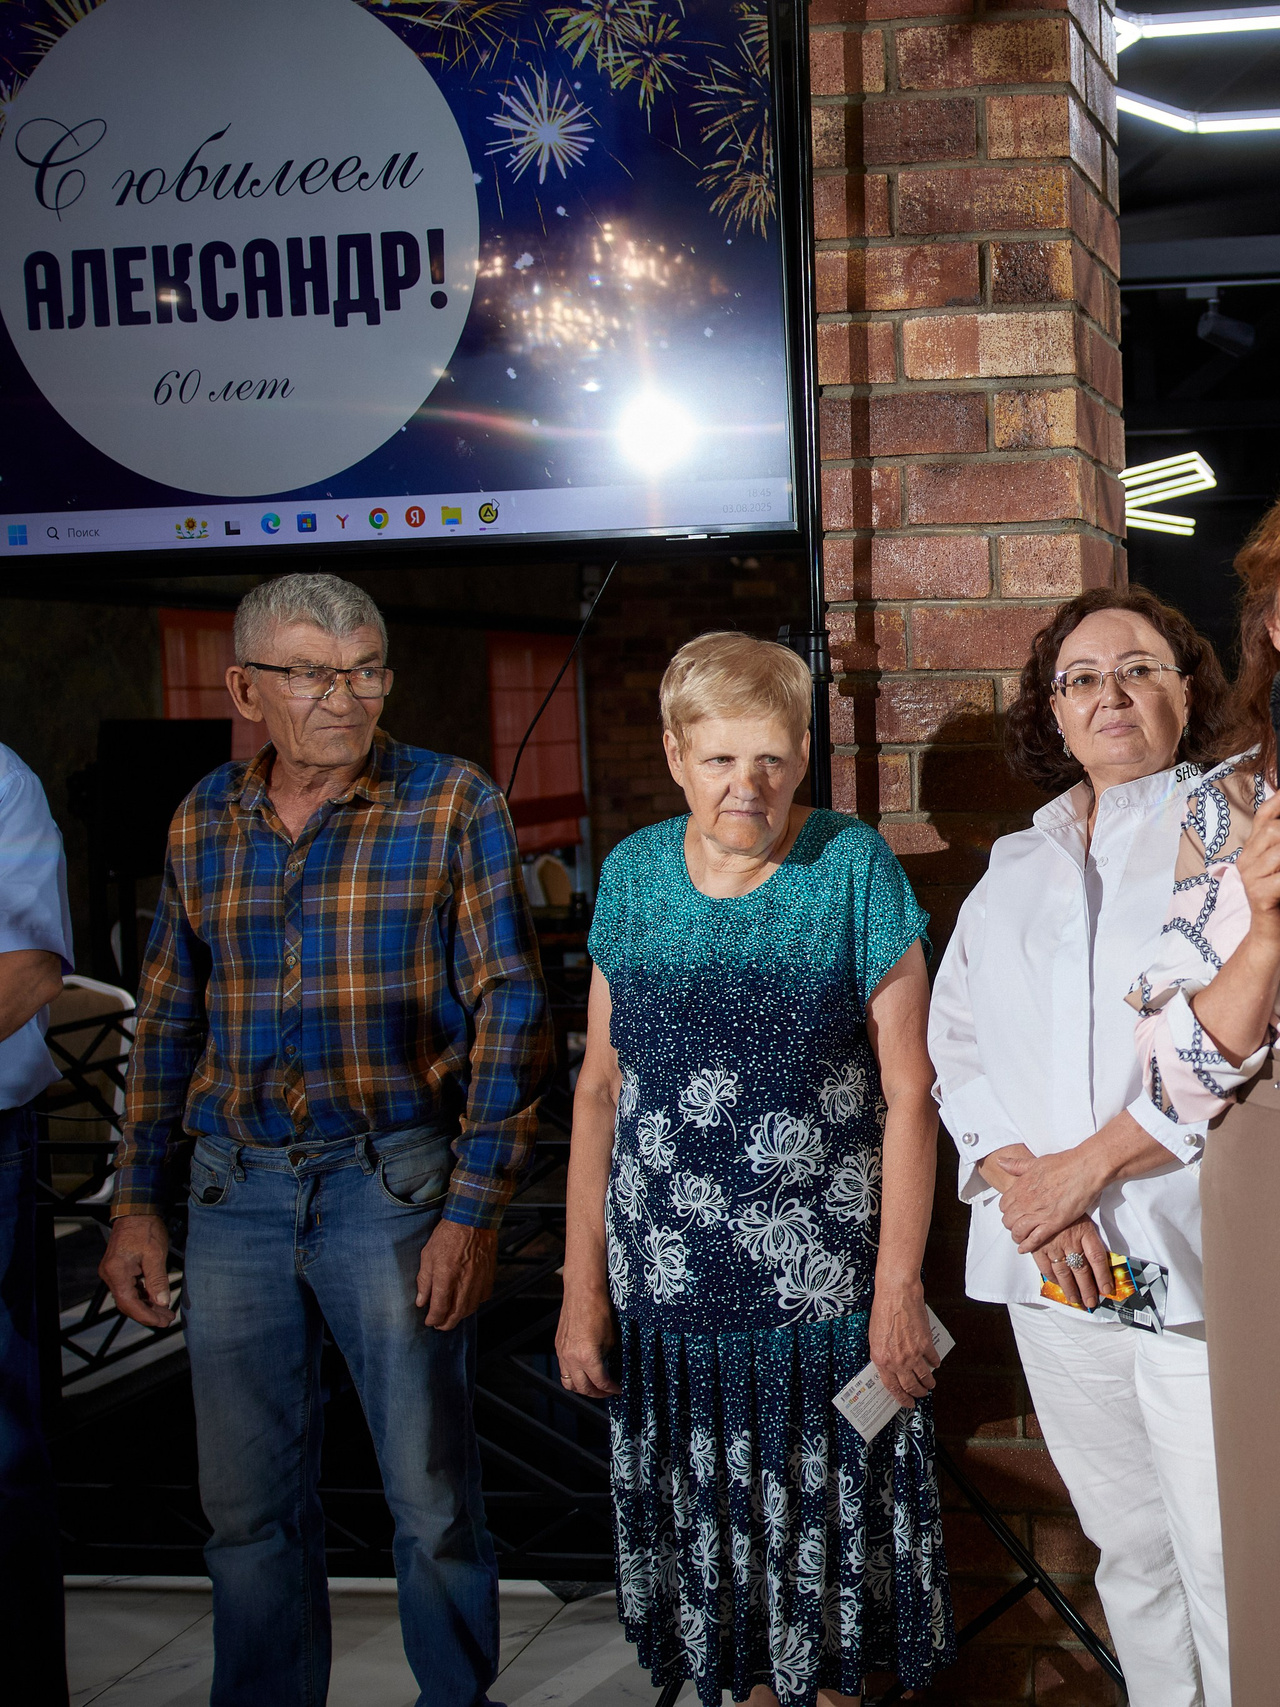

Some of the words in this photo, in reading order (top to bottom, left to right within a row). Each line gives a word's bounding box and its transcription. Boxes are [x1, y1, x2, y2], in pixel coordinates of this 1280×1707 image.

[15, 117, 107, 222] С
[111, 122, 424, 207] юбилеем
[23, 228, 449, 331] АЛЕКСАНДР!
[153, 368, 202, 406] 60
[208, 377, 295, 403] лет
[722, 502, 772, 514] 03.08.2025
[67, 527, 101, 538] Поиск
